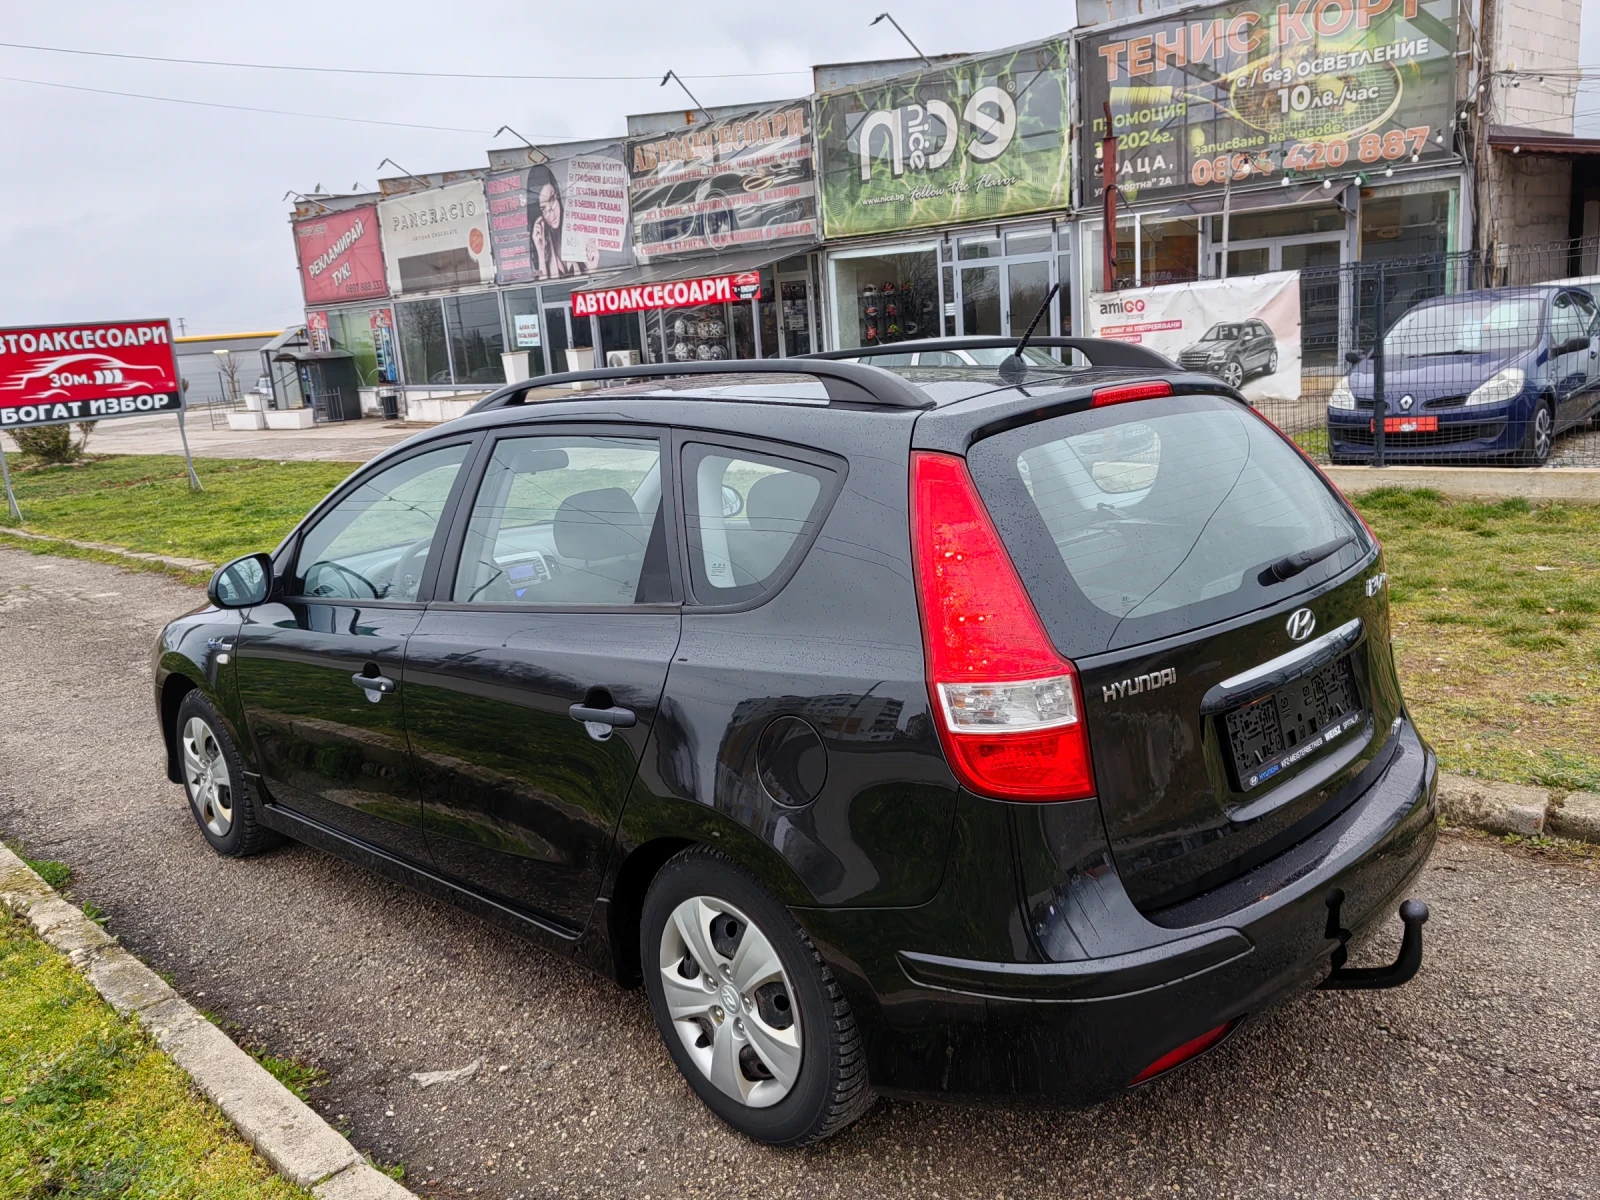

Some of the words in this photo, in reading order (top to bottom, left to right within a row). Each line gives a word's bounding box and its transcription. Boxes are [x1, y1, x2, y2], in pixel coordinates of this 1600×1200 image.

[1099, 11, 1260, 82] ТЕНИС
[1297, 38, 1429, 76] ОСВЕТЛЕНИЕ
[1093, 102, 1186, 132] ПОМОЦИЯ
[633, 107, 804, 172] АВТОАКСЕСОАРИ
[907, 104, 930, 170] nice
[1194, 136, 1265, 158] записване
[1269, 133, 1286, 143] на
[1289, 120, 1346, 140] часове:
[1192, 149, 1275, 186] 0894
[1283, 139, 1349, 171] 420
[1358, 126, 1430, 163] 887
[862, 193, 904, 206] www.nice.bg
[909, 185, 945, 203] Follow
[947, 179, 971, 194] the
[974, 173, 1018, 192] Flavor
[392, 201, 476, 232] PANCRACIO
[431, 228, 458, 239] CHOCOLATE
[308, 217, 365, 279] РЕКЛАМИРАЙ
[332, 261, 352, 287] ТУК!
[575, 278, 731, 314] АВТОАКСЕСОАРИ
[49, 372, 94, 388] 30м.
[1, 401, 82, 424] БОГАТ
[90, 393, 169, 416] ИЗБОР
[1102, 667, 1177, 703] HYUNDAI
[1259, 764, 1279, 780] HYUNDAI
[1324, 724, 1342, 742] WEISZ
